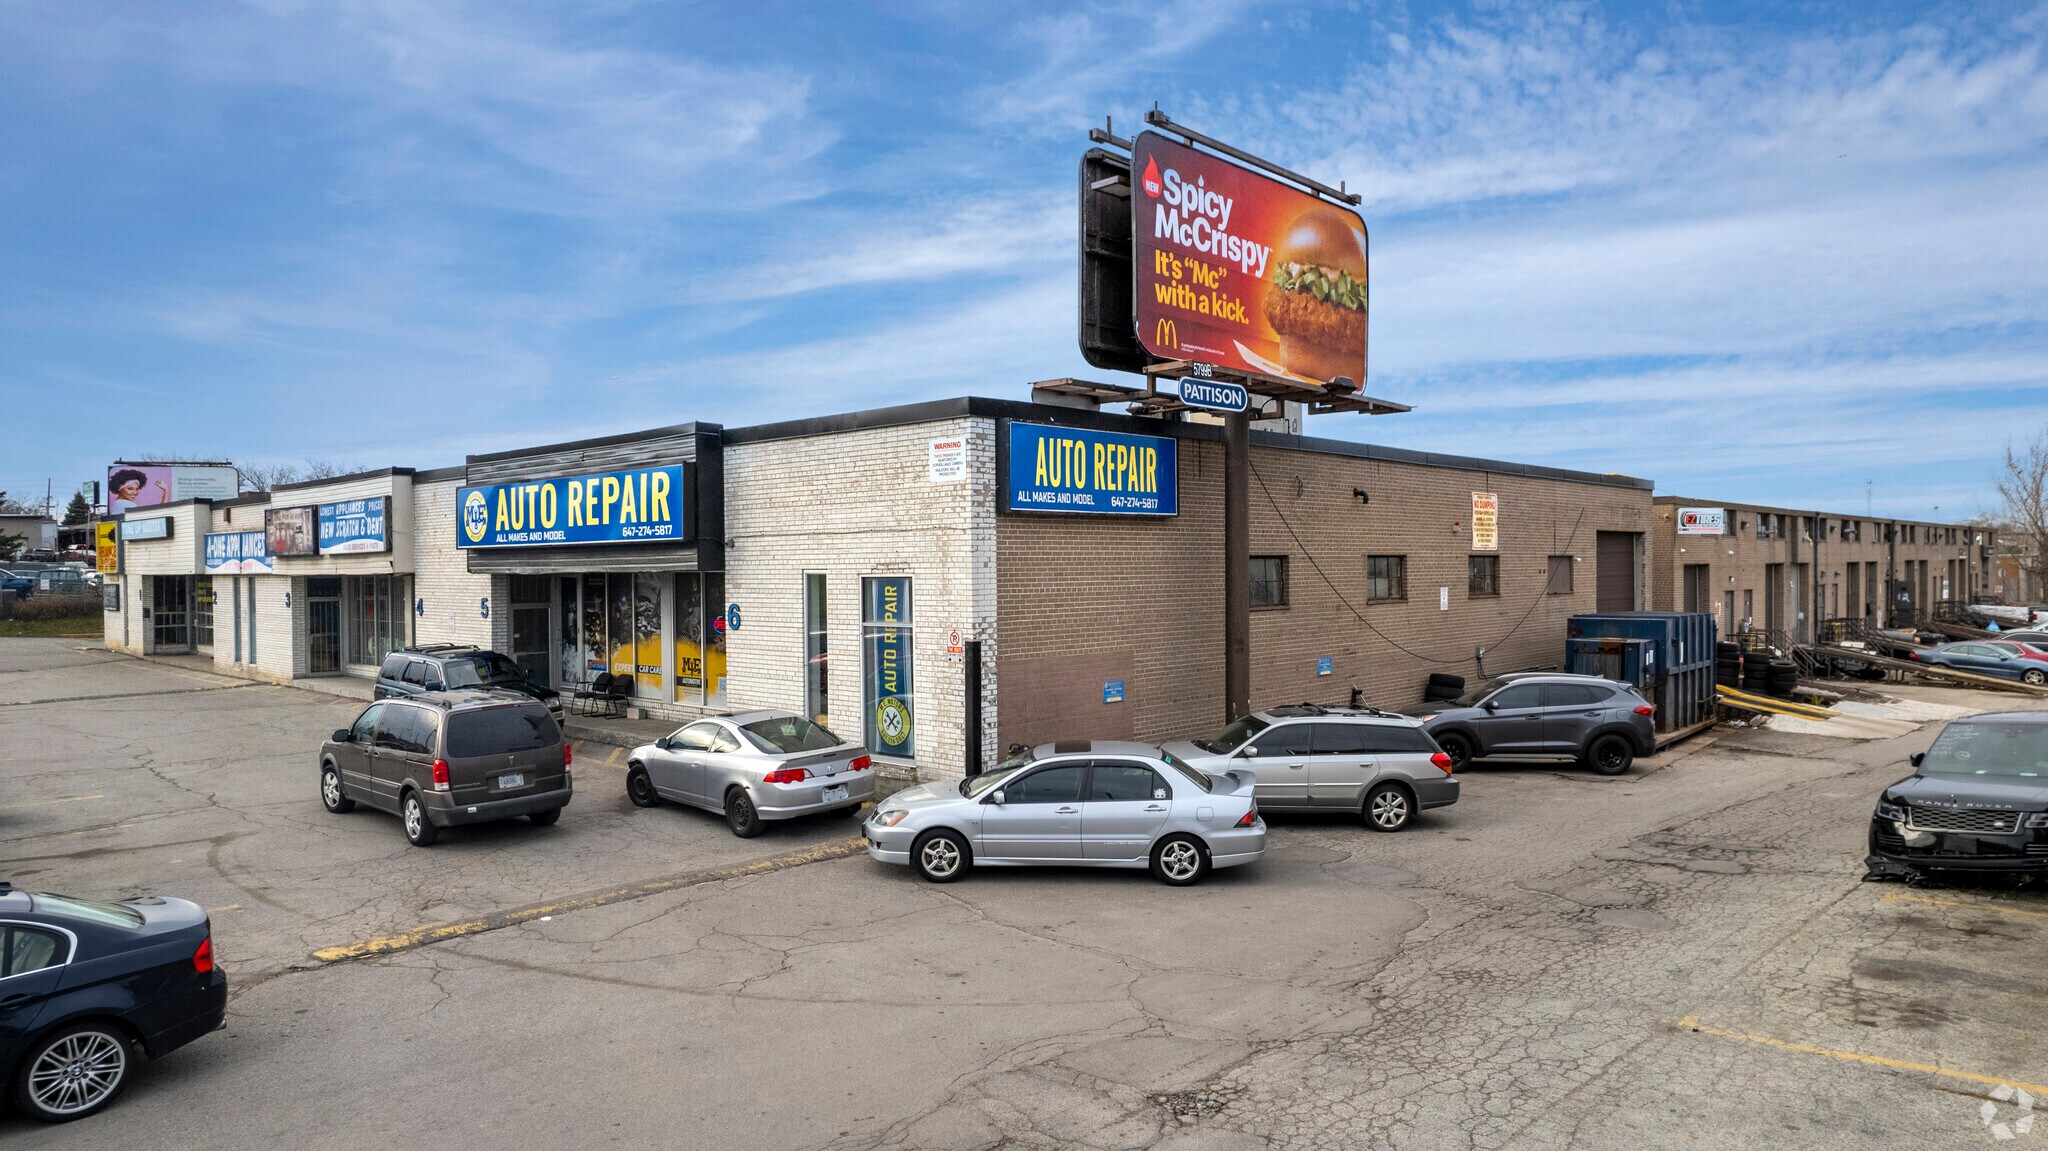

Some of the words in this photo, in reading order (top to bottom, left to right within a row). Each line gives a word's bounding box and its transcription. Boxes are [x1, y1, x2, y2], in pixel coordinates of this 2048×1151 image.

[1145, 180, 1159, 194] NEW
[1163, 168, 1233, 231] Spicy
[1155, 249, 1183, 279] It's
[1155, 280, 1197, 311] with
[1198, 294, 1210, 314] a
[1212, 291, 1249, 325] kick.
[1193, 362, 1213, 377] 5799B
[1184, 382, 1242, 406] PATTISON
[933, 441, 962, 450] WARNING
[1035, 436, 1086, 489] AUTO
[1094, 442, 1157, 493] REPAIR
[495, 483, 557, 531] AUTO
[568, 471, 671, 527] REPAIR
[1018, 490, 1031, 502] ALL
[1032, 491, 1056, 503] MAKES
[1057, 492, 1071, 504] AND
[1072, 493, 1095, 505] MODEL
[1111, 496, 1159, 509] 647-274-5817
[336, 500, 365, 515] APPLIANCES
[320, 522, 335, 539] NEW
[336, 519, 359, 537] SCRATCH
[360, 519, 366, 536] &
[367, 516, 383, 535] DENT
[496, 533, 508, 543] ALL
[508, 532, 528, 542] MAKES
[529, 531, 543, 541] AND
[543, 530, 566, 540] MODEL
[622, 525, 673, 537] 647-274-5817
[206, 535, 226, 558] A-ONE
[212, 590, 218, 605] 2
[285, 592, 291, 608] 3
[416, 598, 424, 617] 4
[480, 597, 489, 619] 5
[728, 603, 741, 630] 6
[884, 586, 897, 644] REPAIR
[638, 665, 649, 673] CAR
[649, 666, 663, 675] CARE
[884, 647, 897, 692] AUTO
[1917, 799, 1959, 808] RANGE
